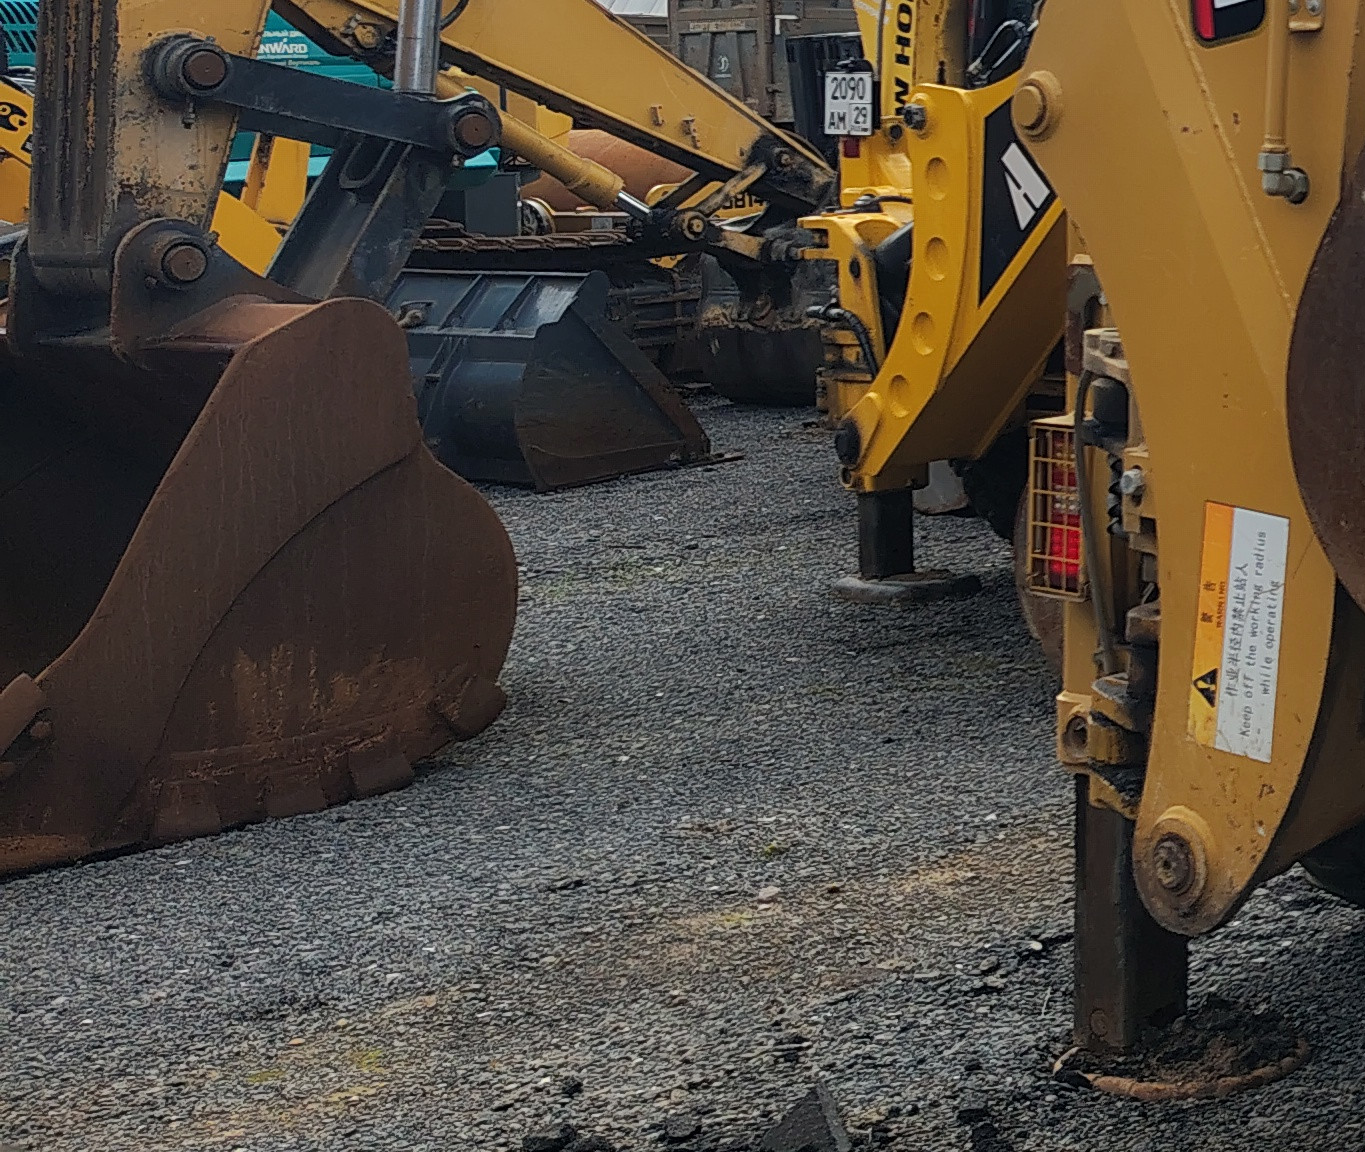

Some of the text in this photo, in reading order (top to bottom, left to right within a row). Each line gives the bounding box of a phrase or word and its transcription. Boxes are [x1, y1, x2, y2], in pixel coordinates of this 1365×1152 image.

[830, 76, 867, 101] 2090
[853, 106, 868, 124] 29
[1252, 531, 1266, 576] radius
[1249, 584, 1263, 638] working
[1260, 580, 1279, 695] while operating
[1245, 645, 1257, 666] the
[1239, 705, 1253, 737] Keep
